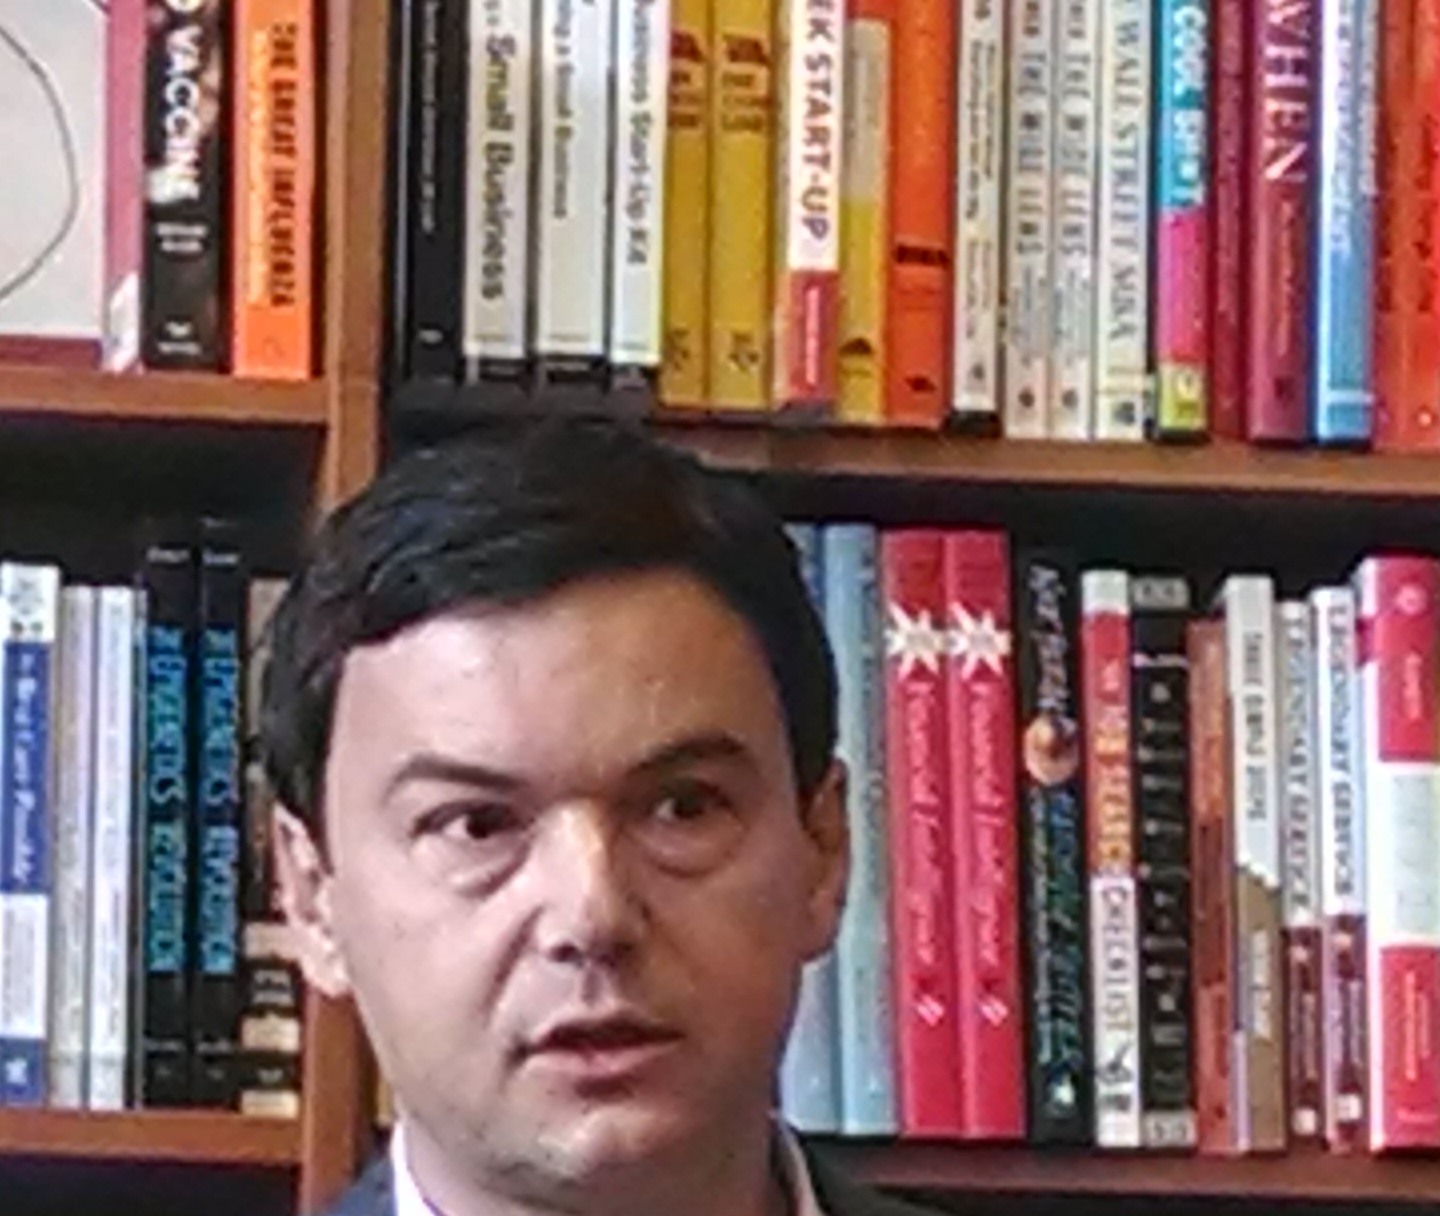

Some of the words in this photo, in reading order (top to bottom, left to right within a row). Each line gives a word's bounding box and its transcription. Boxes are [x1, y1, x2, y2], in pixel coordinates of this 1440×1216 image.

[270, 23, 298, 67] THE
[483, 35, 517, 131] Small
[270, 79, 298, 157] GREAT
[803, 54, 834, 242] START-UP
[268, 168, 296, 308] INFLUENZA
[481, 142, 514, 300] Business
